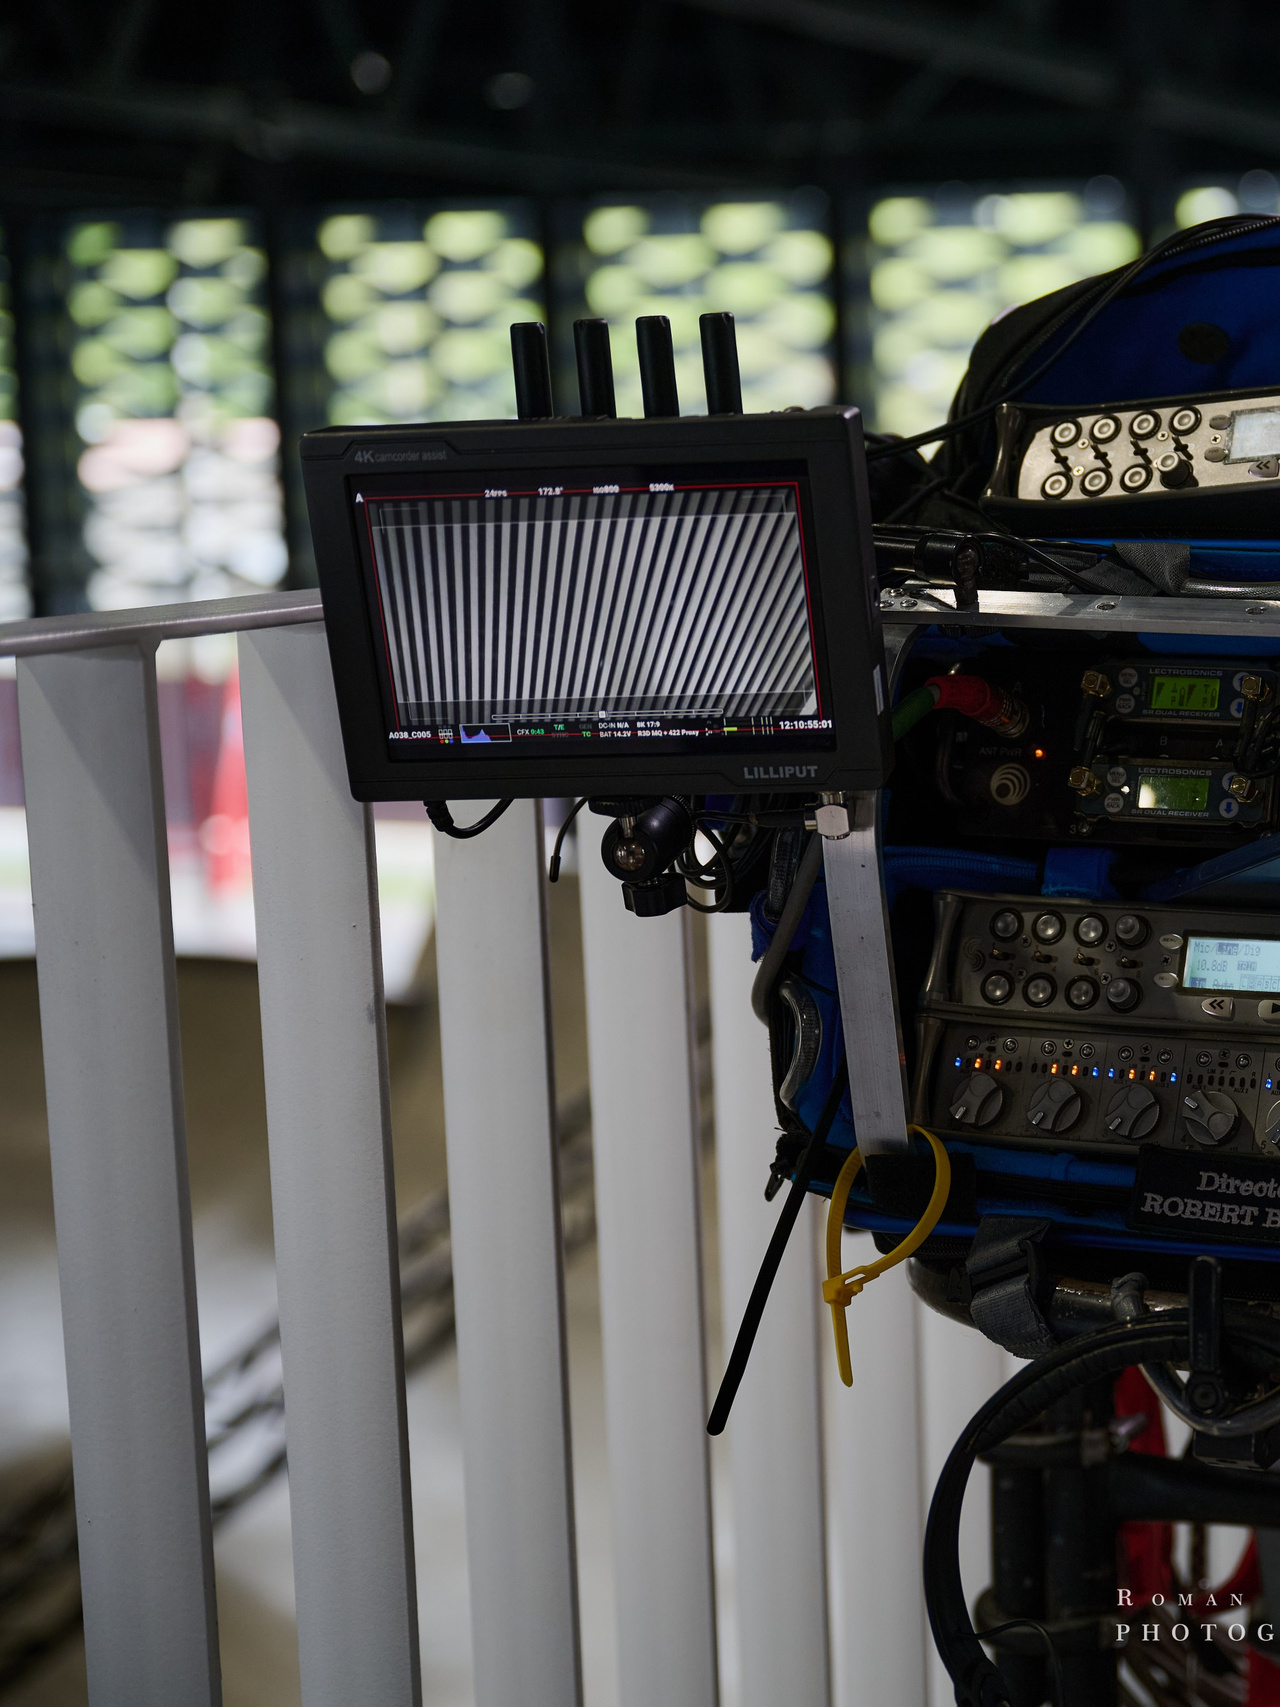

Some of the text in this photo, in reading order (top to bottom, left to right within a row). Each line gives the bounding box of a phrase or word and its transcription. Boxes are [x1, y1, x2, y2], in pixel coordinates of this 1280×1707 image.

[354, 450, 447, 462] 4K camcorder assist
[355, 492, 364, 503] A
[1149, 668, 1223, 677] LECTROSONICS
[1179, 710, 1220, 718] RECEIVER
[779, 719, 833, 729] 12:10:55:01
[389, 731, 431, 740] A038_C005
[681, 729, 699, 737] Proxy
[1160, 736, 1167, 746] B
[1216, 738, 1223, 748] A
[979, 747, 1022, 757] ANT PWR
[743, 766, 818, 779] LILLIPUT
[1138, 768, 1212, 776] LECTROSONICS
[1168, 810, 1209, 818] RECEIVER
[1069, 825, 1076, 835] 3
[1261, 1140, 1267, 1149] 5
[1140, 1192, 1259, 1227] ROBERT
